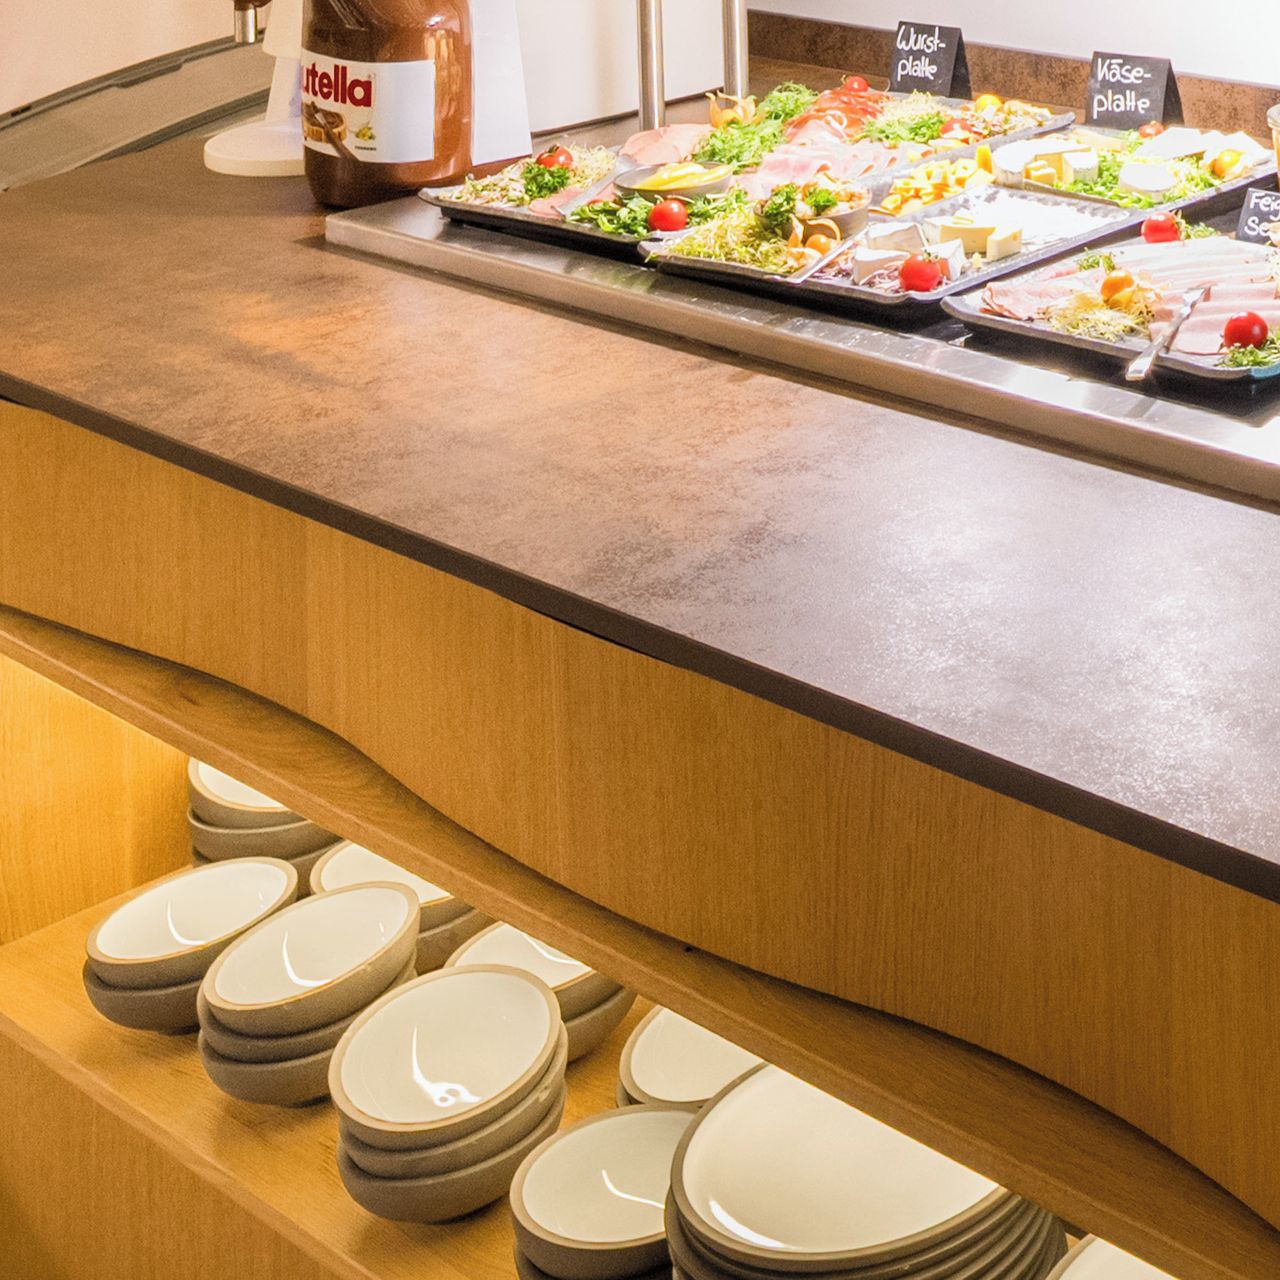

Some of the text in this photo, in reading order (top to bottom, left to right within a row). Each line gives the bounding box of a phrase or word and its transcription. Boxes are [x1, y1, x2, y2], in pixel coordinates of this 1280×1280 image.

[896, 24, 947, 53] Wurst-
[1097, 57, 1152, 84] Käse-
[1092, 89, 1151, 120] platte
